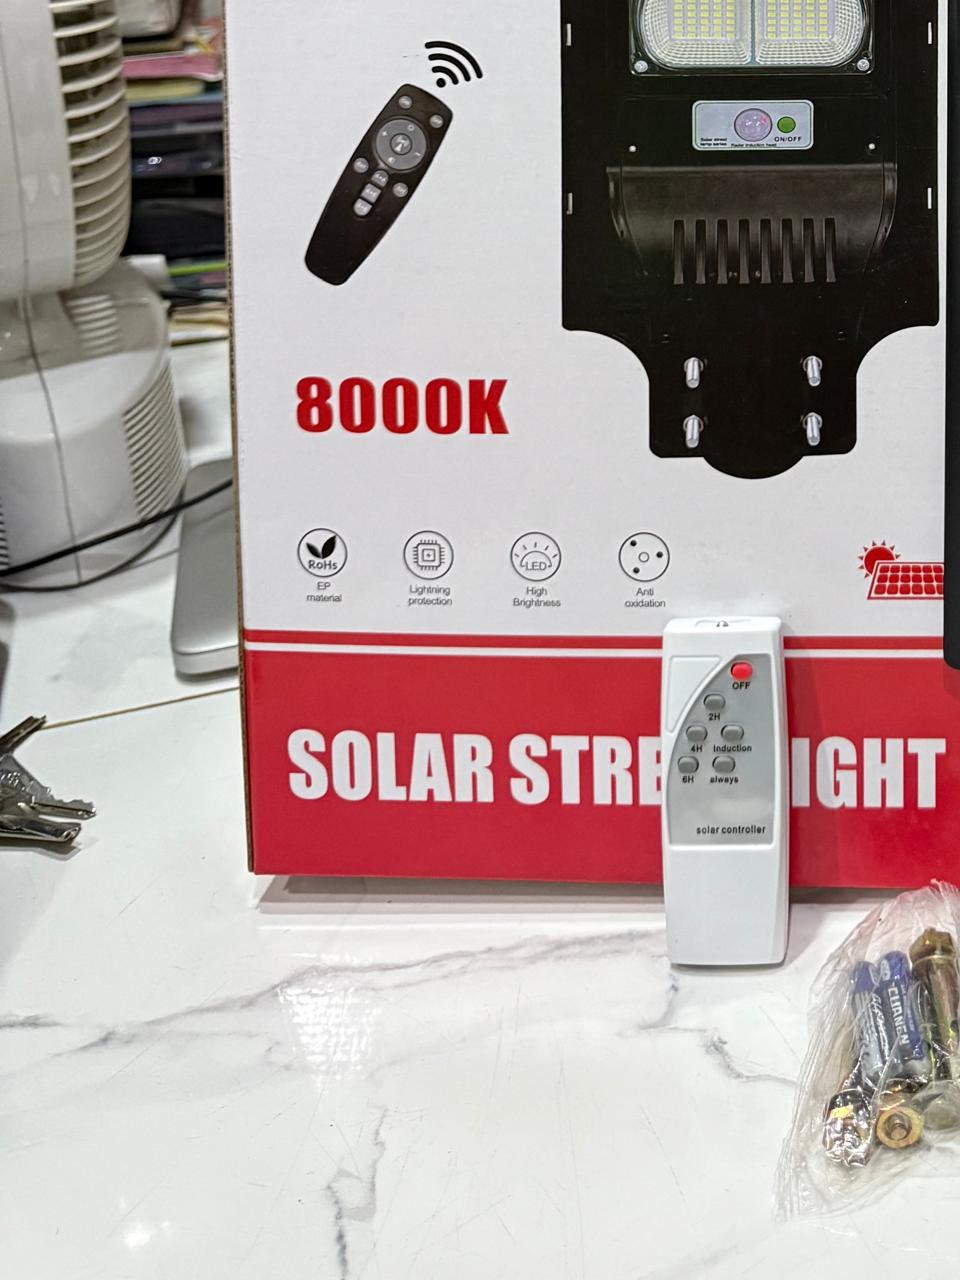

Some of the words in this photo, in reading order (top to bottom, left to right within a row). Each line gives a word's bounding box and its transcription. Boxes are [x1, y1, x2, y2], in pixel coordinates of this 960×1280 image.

[296, 376, 509, 435] 8000K
[308, 559, 338, 570] RoHs
[525, 560, 547, 571] LED
[317, 582, 331, 590] EP
[410, 584, 451, 596] Lightning
[526, 587, 547, 597] High
[636, 587, 654, 597] Anti
[306, 593, 342, 603] material
[408, 596, 452, 606] protection
[513, 597, 561, 609] Brightness
[625, 597, 666, 608] oxidation
[732, 681, 750, 690] OFF
[708, 712, 721, 721] 2H
[690, 744, 703, 753] 4H
[288, 729, 493, 804] SOLAR
[508, 732, 662, 806] STRE
[792, 736, 946, 809] IGHT
[682, 775, 695, 784] 6H
[709, 776, 739, 786] always
[696, 825, 719, 834] solar
[721, 825, 766, 834] controller
